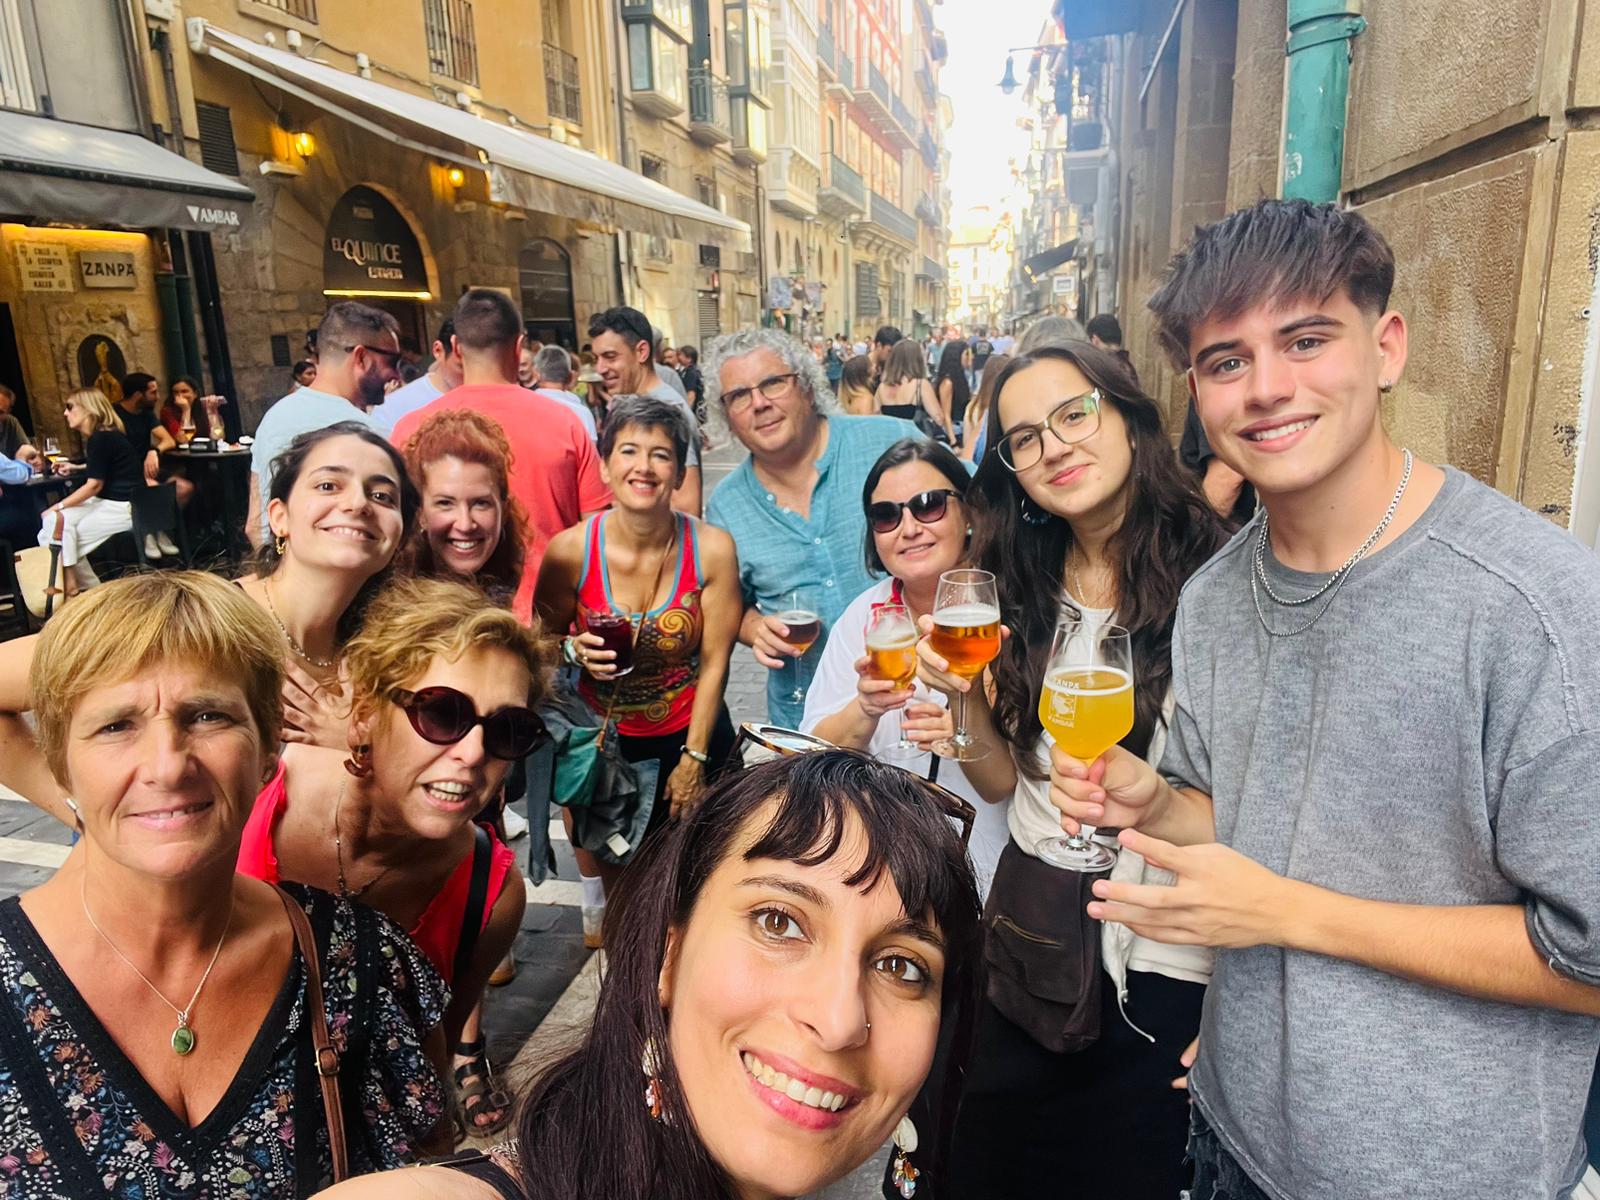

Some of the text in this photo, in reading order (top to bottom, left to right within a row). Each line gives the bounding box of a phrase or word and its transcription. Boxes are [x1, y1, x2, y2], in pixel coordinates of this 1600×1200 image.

[200, 207, 240, 226] AMBAR
[343, 238, 402, 266] QUINCE
[82, 262, 135, 277] ZANPA
